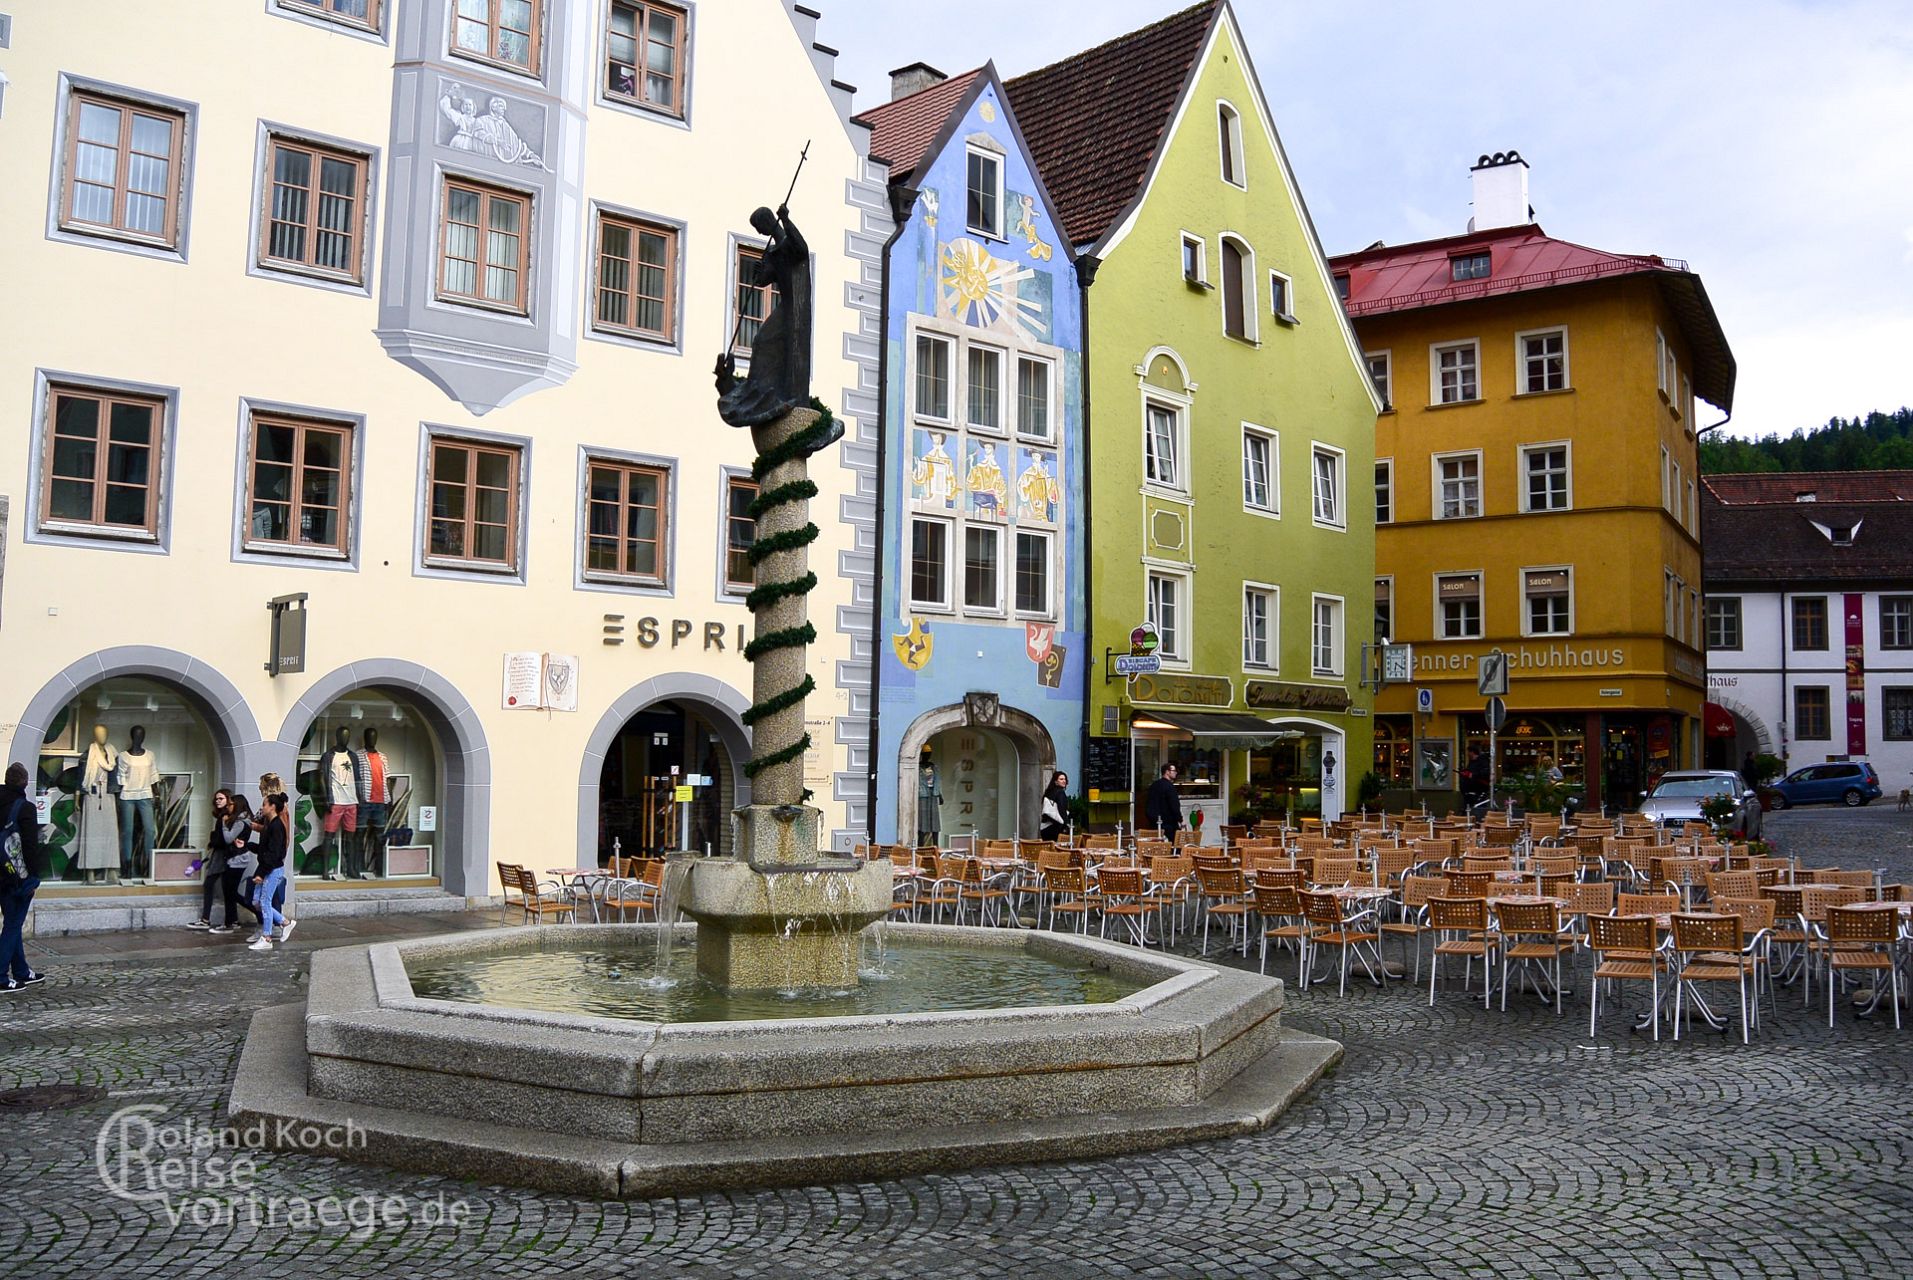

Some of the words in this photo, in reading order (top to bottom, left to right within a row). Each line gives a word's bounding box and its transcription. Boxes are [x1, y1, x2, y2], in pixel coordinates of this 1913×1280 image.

[603, 613, 745, 652] ESPRI
[280, 656, 299, 665] ESPRIT
[1708, 674, 1738, 687] haus
[960, 738, 974, 827] ESPRI
